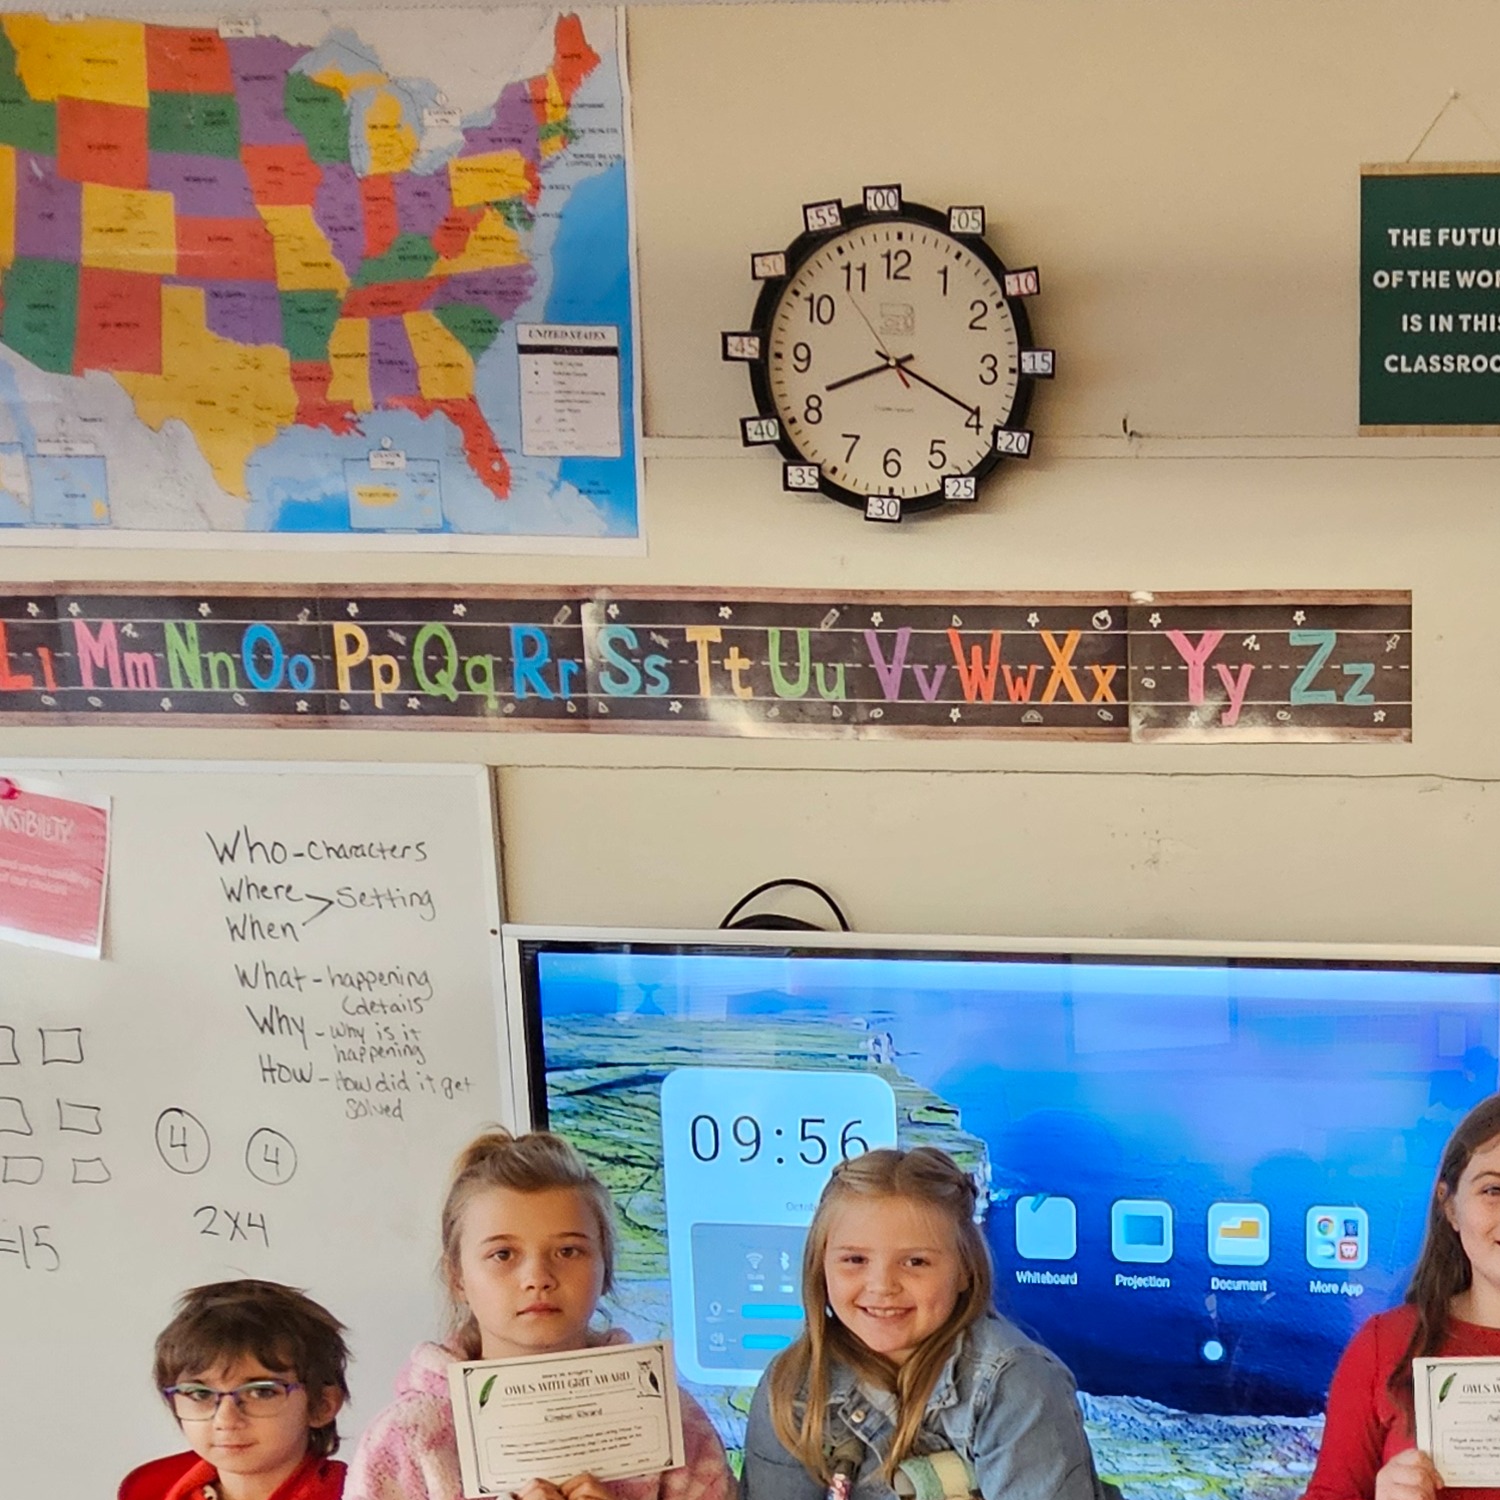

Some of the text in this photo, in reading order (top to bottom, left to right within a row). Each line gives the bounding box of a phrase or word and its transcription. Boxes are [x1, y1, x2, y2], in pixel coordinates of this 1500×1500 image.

[867, 190, 898, 210] :00
[809, 207, 839, 227] :55
[952, 210, 982, 229] :05
[1387, 228, 1431, 246] THE
[881, 250, 912, 280] 12
[841, 262, 867, 293] 11
[937, 265, 948, 296] 1
[1007, 273, 1037, 293] :10
[1373, 270, 1403, 288] OF
[1407, 270, 1450, 288] THE
[804, 294, 835, 325] 10
[968, 300, 987, 331] 2
[1402, 314, 1423, 332] IS
[1430, 314, 1453, 332] IN
[792, 342, 811, 373] 9
[1023, 354, 1052, 373] :15
[978, 354, 998, 385] 3
[803, 394, 822, 425] 8
[748, 419, 778, 438] :40
[965, 406, 984, 435] 4
[841, 434, 860, 463] 7
[999, 434, 1028, 453] :20
[883, 448, 902, 478] 6
[928, 439, 947, 470] 5
[788, 468, 818, 486] :35
[946, 480, 975, 498] :25
[869, 500, 899, 519] :30
[220, 875, 302, 903] Where
[226, 913, 300, 943] When
[375, 1022, 396, 1042] is
[401, 1025, 422, 1043] it
[335, 1044, 426, 1065] happening
[375, 1073, 408, 1093] did
[440, 1076, 476, 1099] get
[1015, 1270, 1078, 1286] Whiteboard
[1115, 1274, 1170, 1290] Projection
[1211, 1277, 1267, 1292] Document
[1310, 1280, 1363, 1297] More App
